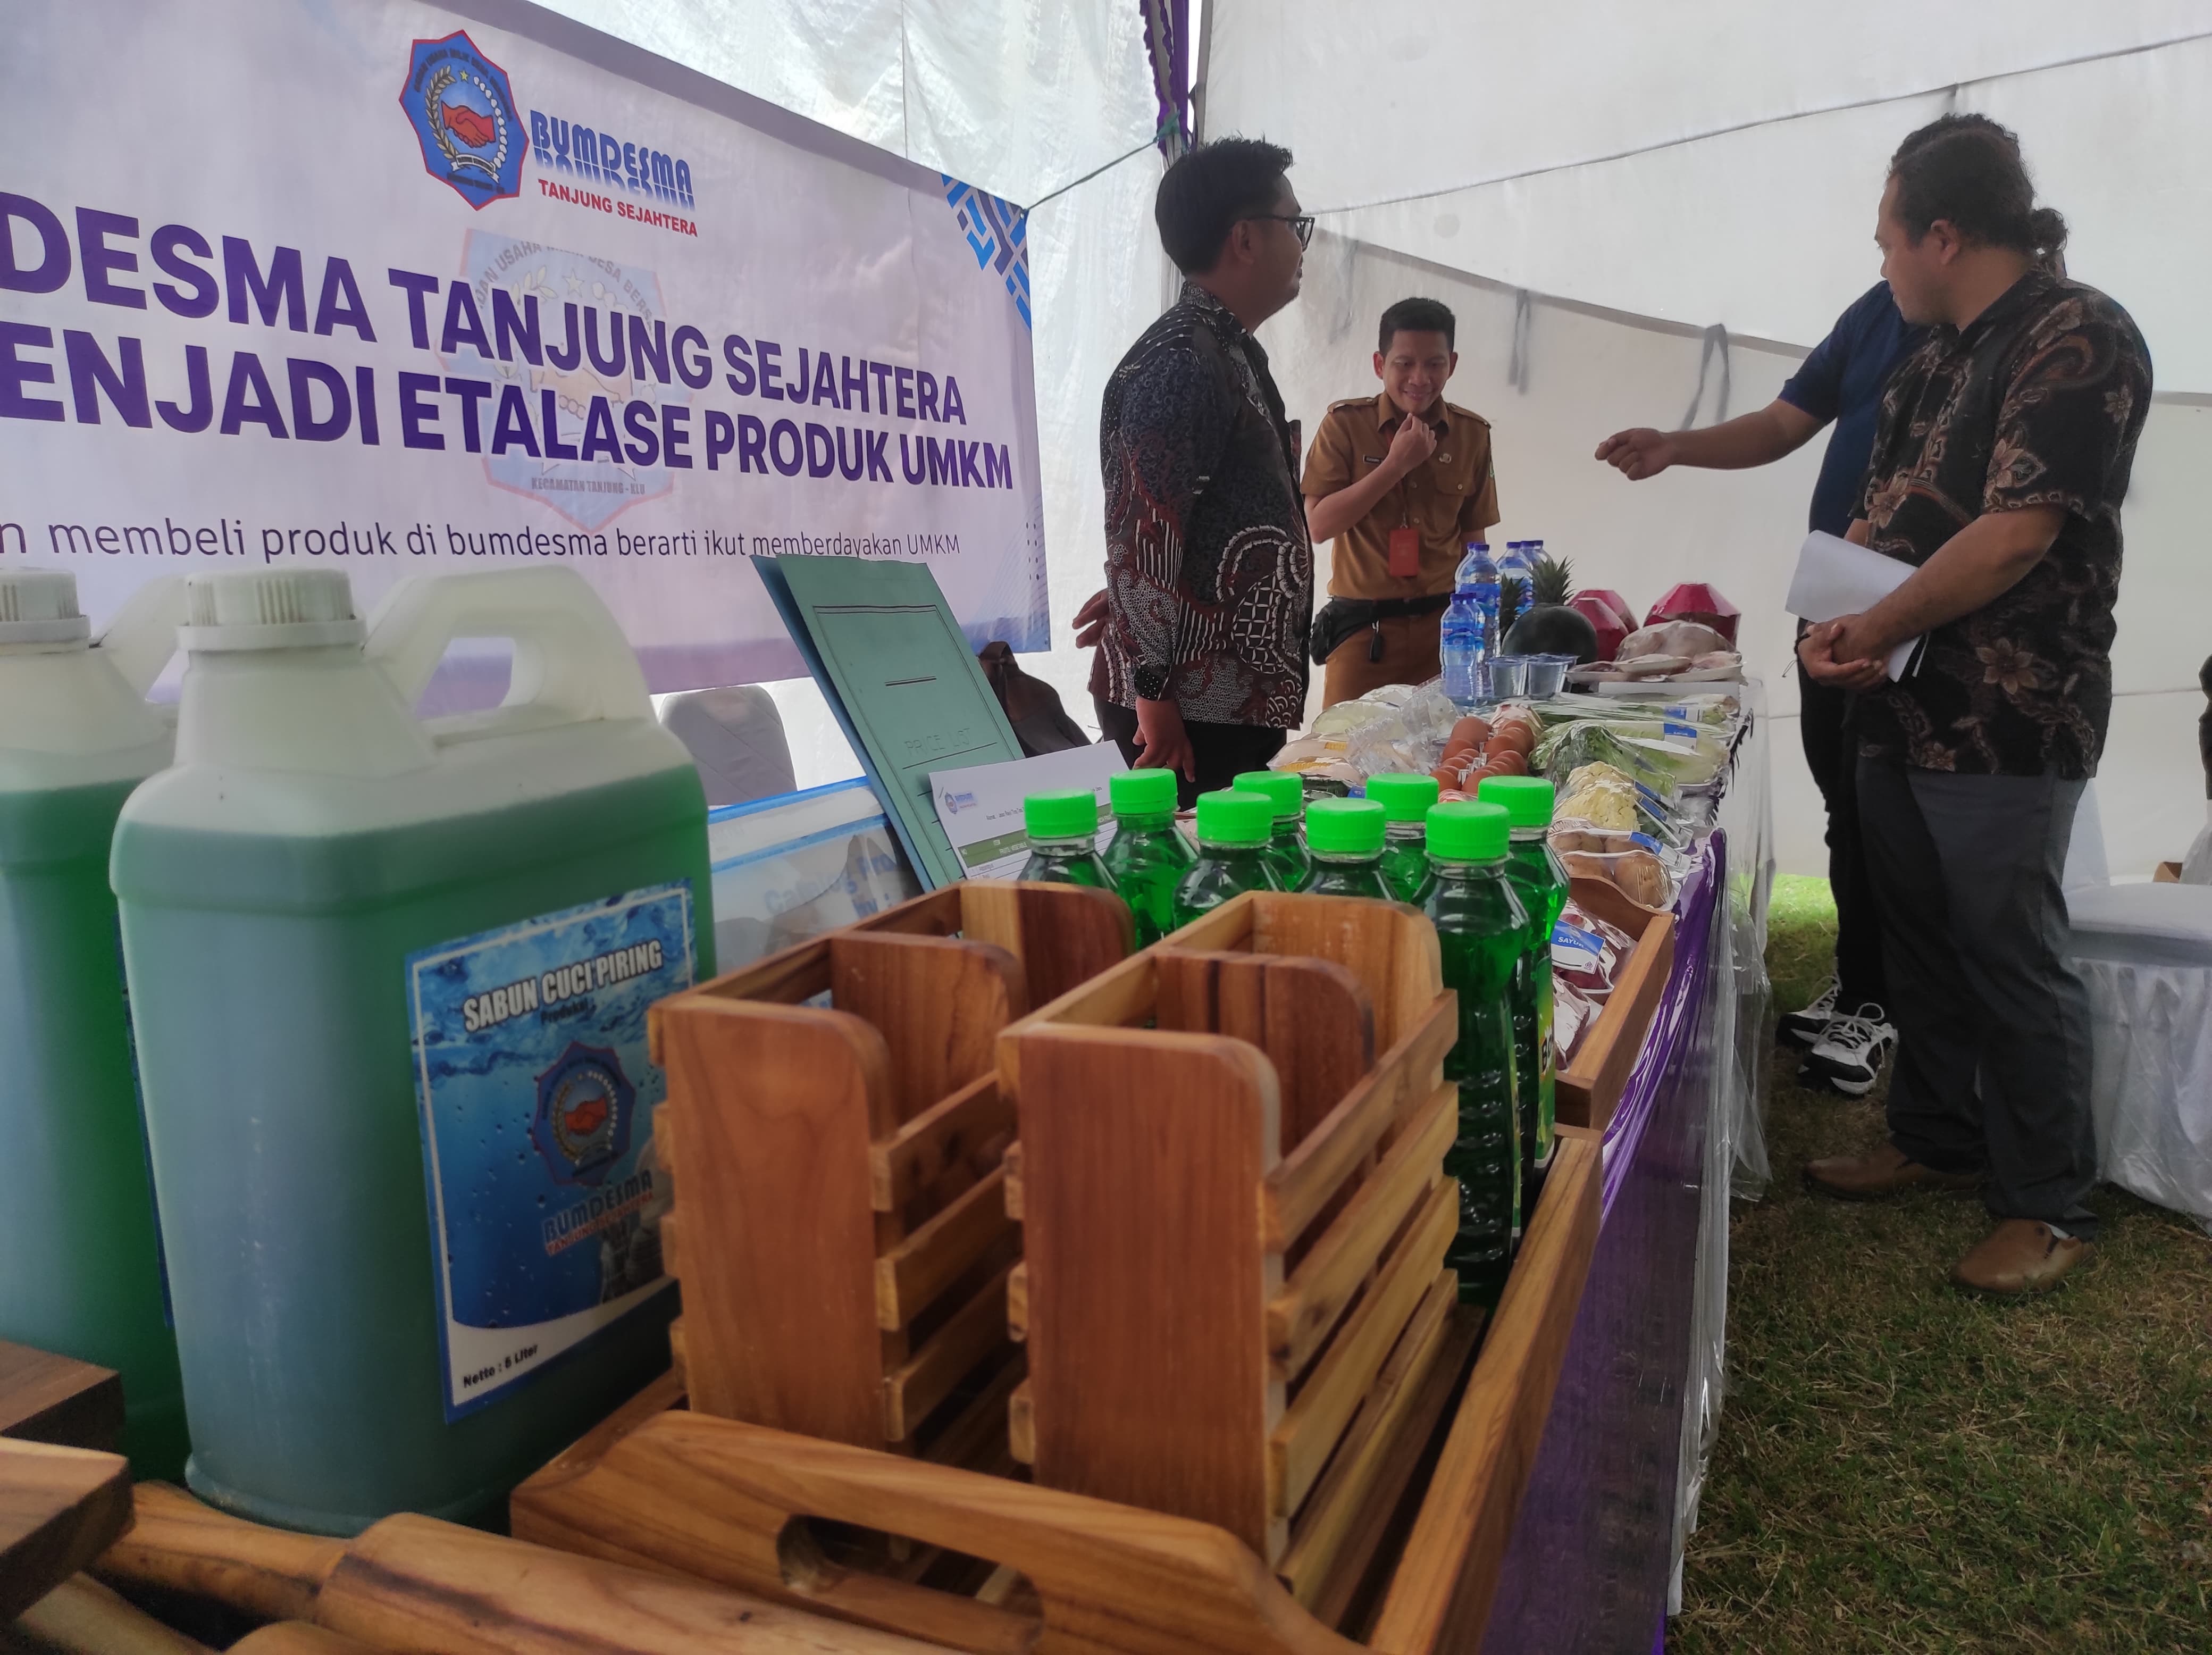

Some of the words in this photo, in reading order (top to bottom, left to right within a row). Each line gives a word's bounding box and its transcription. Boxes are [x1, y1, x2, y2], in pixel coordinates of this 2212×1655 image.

[530, 110, 693, 194] BUMDESMA
[538, 179, 613, 213] TANJUNG
[617, 202, 698, 237] SEJAHTERA
[0, 192, 376, 342] DESMA
[388, 269, 712, 389] TANJUNG
[723, 335, 966, 425] SEJAHTERA
[0, 321, 380, 446] ENJADI
[399, 371, 692, 469] ETALASE
[705, 410, 893, 483] PRODUK
[899, 433, 1012, 489] UMKM
[532, 478, 585, 492] KECAMATAN
[586, 480, 624, 494] TANJUNG
[631, 482, 646, 495] KLU
[48, 517, 245, 555] membeli
[262, 521, 398, 564] produk
[407, 523, 437, 555] di
[446, 524, 607, 556] bumdesma
[616, 528, 697, 556] berarti
[704, 529, 746, 556] ikut
[752, 531, 902, 559] memberdayakan
[907, 534, 960, 555] UMKM
[464, 977, 539, 1032] SABUN
[542, 960, 593, 1005] CUCI
[596, 940, 663, 987] PIRING
[543, 1169, 652, 1242] BUMDESMA
[463, 1366, 496, 1389] Netto
[514, 1344, 538, 1364] Liter
